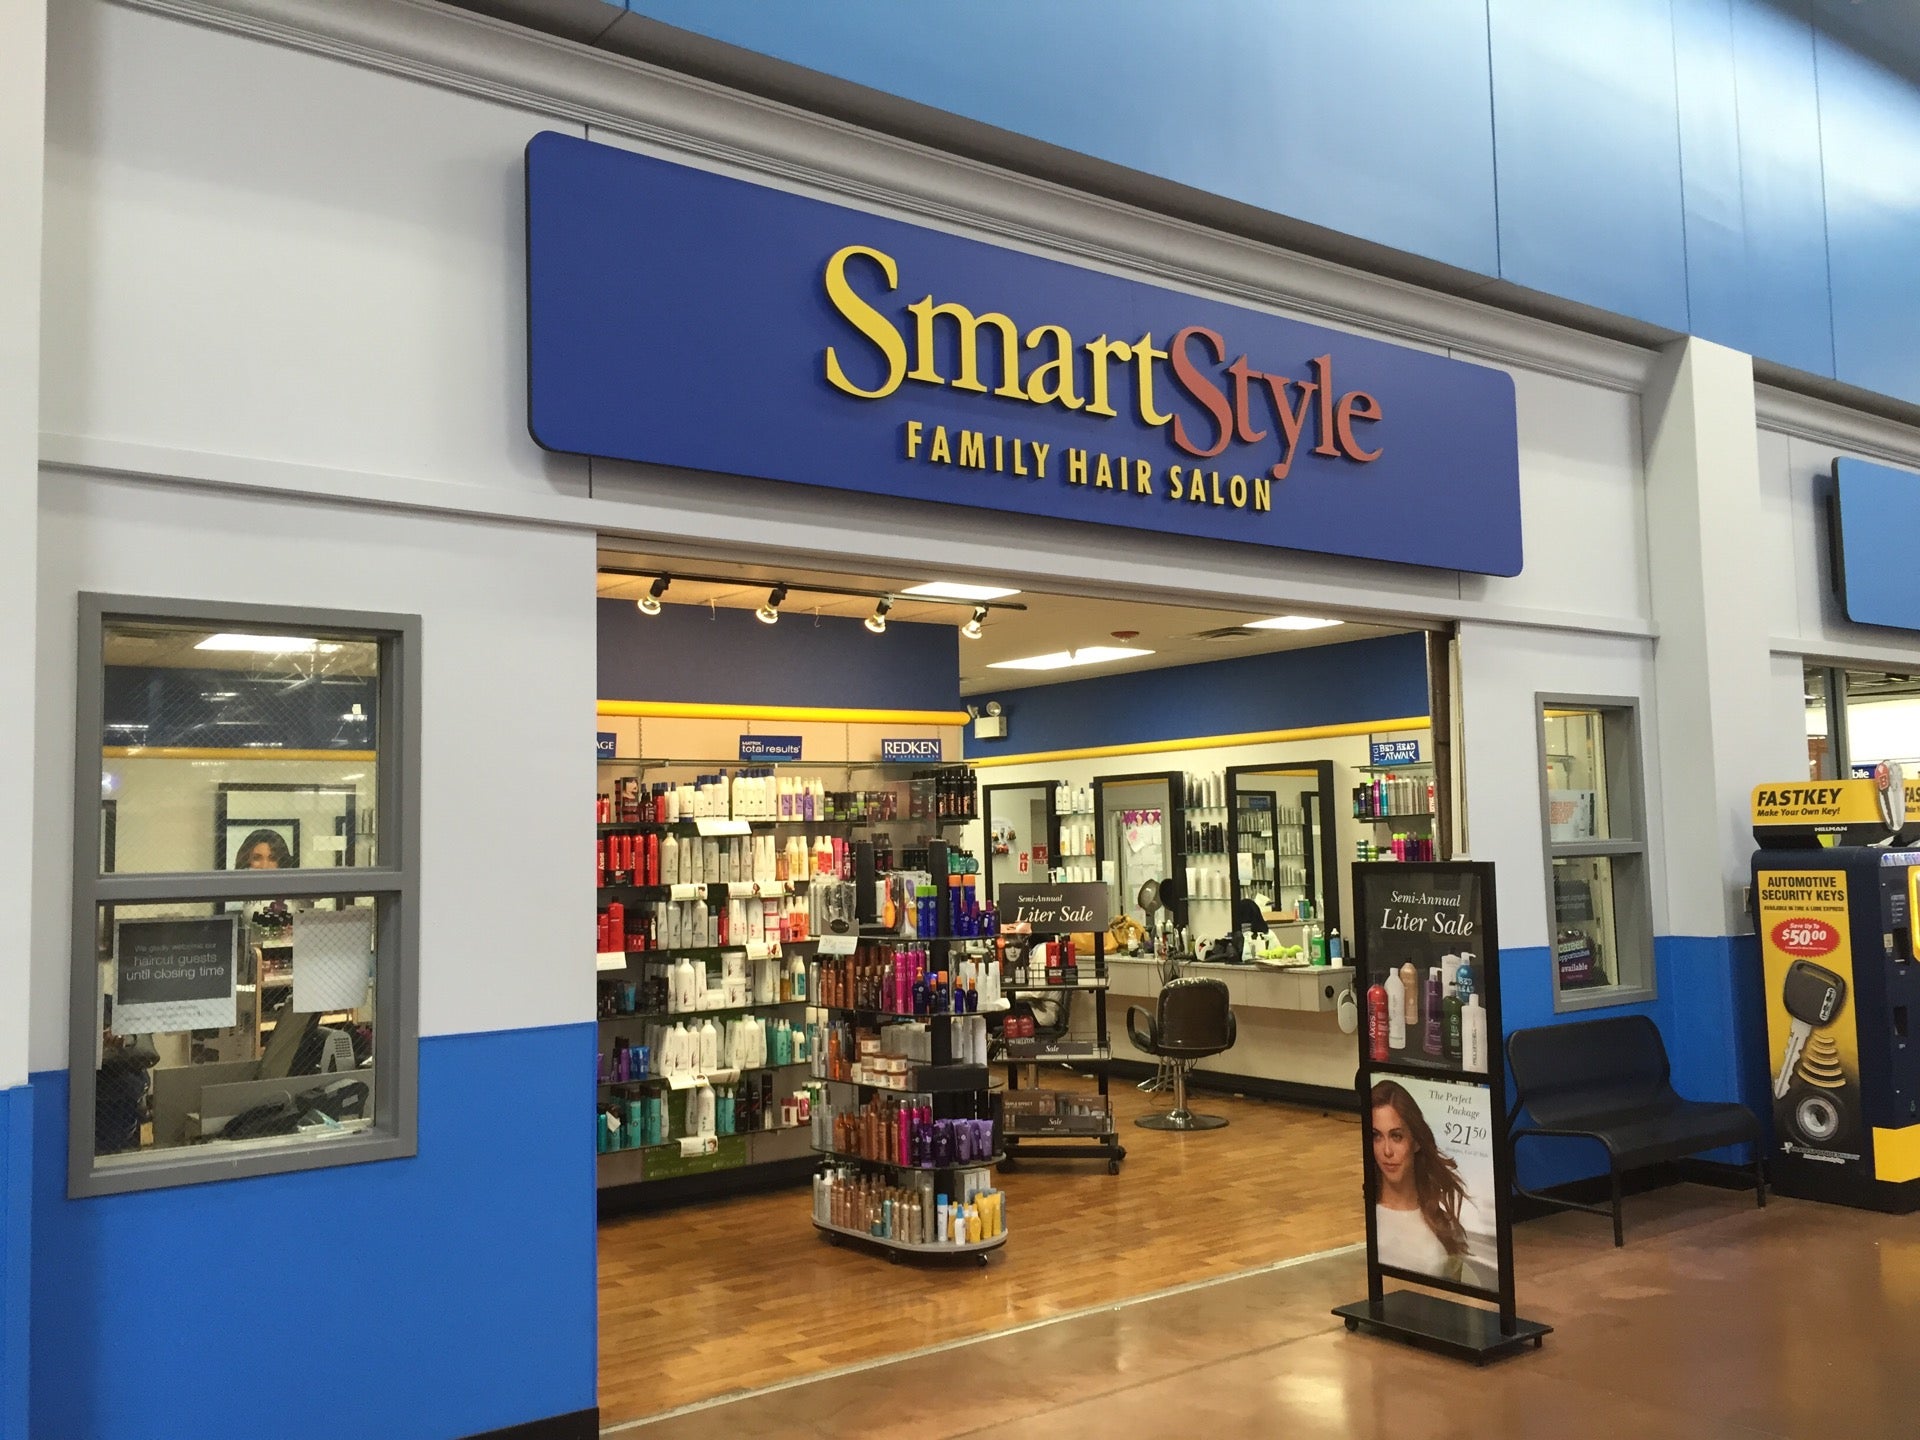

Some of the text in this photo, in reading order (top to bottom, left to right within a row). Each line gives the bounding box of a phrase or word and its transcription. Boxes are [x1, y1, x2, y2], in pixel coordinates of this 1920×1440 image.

[906, 421, 1272, 512] FAMILY HAIR SALON
[742, 744, 800, 754] total results
[884, 741, 939, 754] REDKEN
[1379, 742, 1416, 752] BED HEAD
[1757, 788, 1843, 807] FASTKEY
[1757, 807, 1841, 817] Make Your Own Key!
[1767, 876, 1837, 888] AUTOMOTIVE
[1018, 894, 1063, 903] Semi-Annual
[1391, 890, 1461, 907] Semi-Annual
[1761, 889, 1845, 902] SECURITY KEYS
[1016, 905, 1094, 923] Liter Sale
[1381, 908, 1474, 936] Liter Sale
[1558, 940, 1585, 953] career
[134, 953, 217, 967] haircut guests
[126, 965, 224, 981] until closing time
[1561, 962, 1588, 973] available
[1429, 1089, 1472, 1105] The Perfect
[1447, 1104, 1481, 1120] Package
